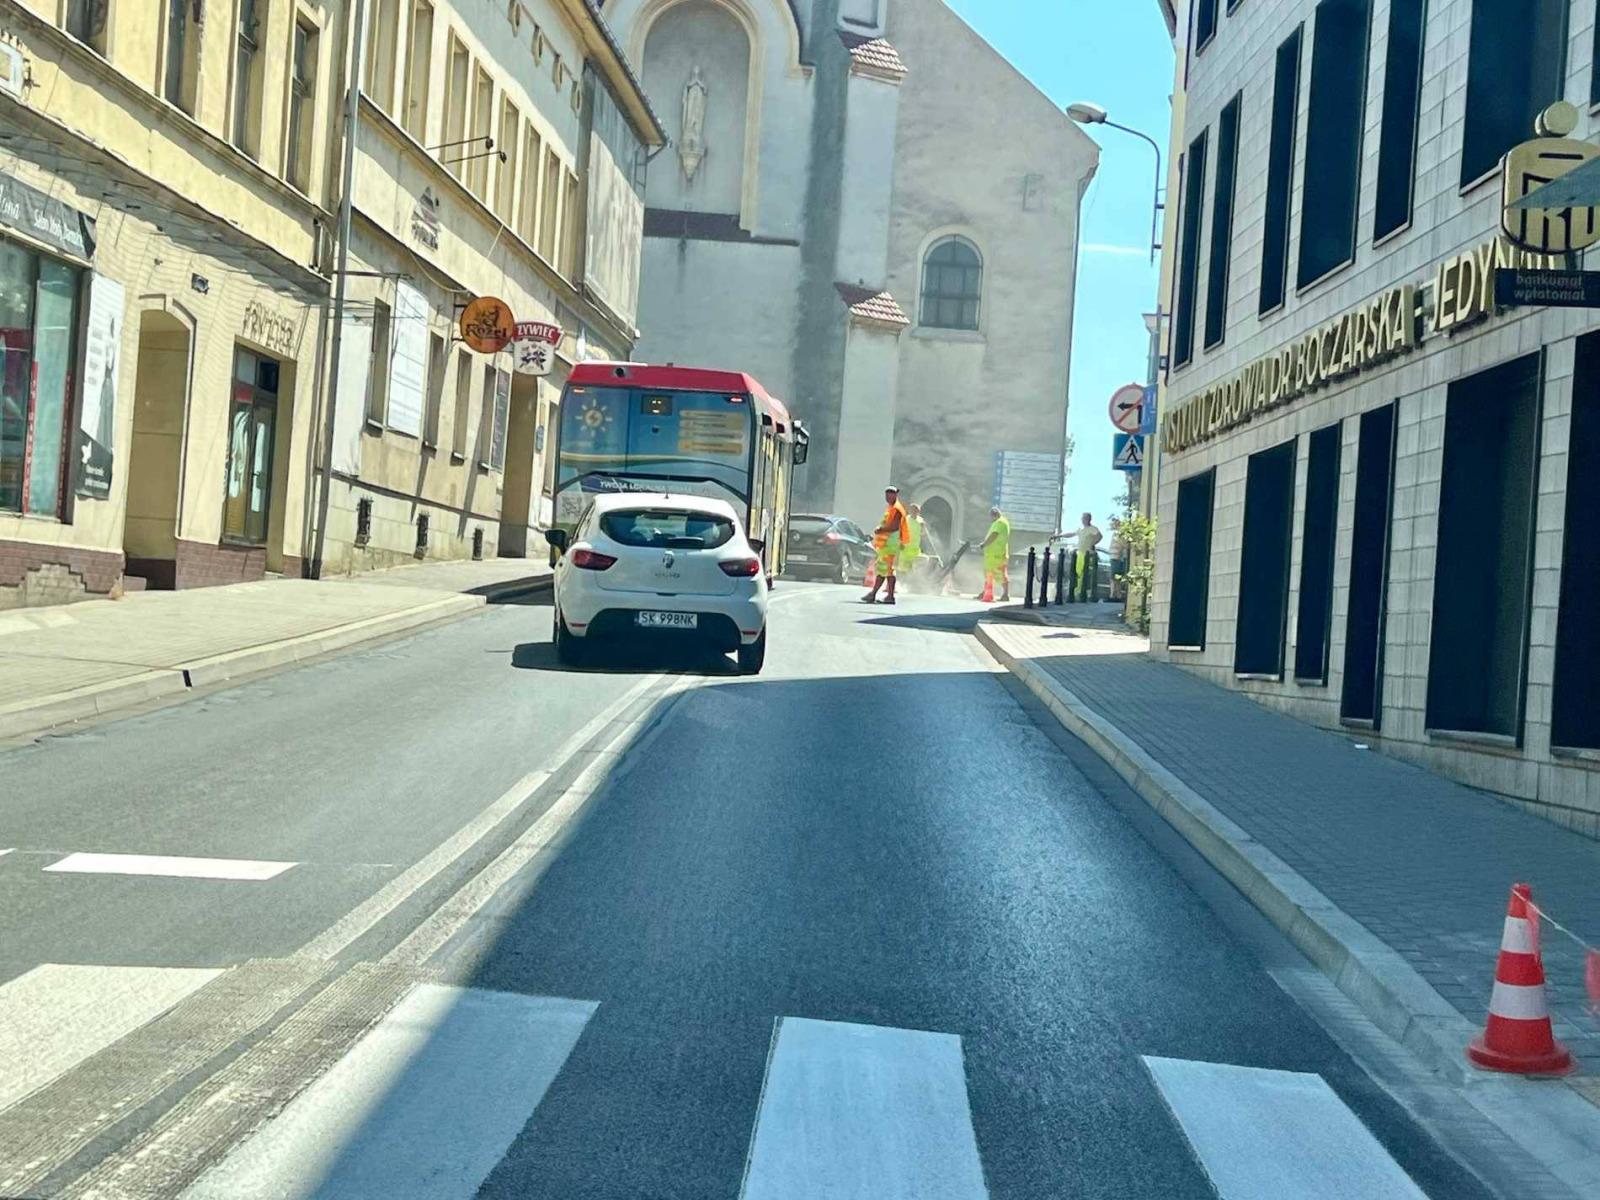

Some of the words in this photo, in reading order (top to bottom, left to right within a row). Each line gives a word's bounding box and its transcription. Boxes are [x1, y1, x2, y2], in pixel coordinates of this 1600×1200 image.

[1207, 357, 1267, 432] ZDROWIA
[1270, 344, 1292, 402] DR
[1295, 284, 1411, 390] BOCZARSKA
[641, 612, 656, 624] SK
[660, 613, 695, 626] 998NK
